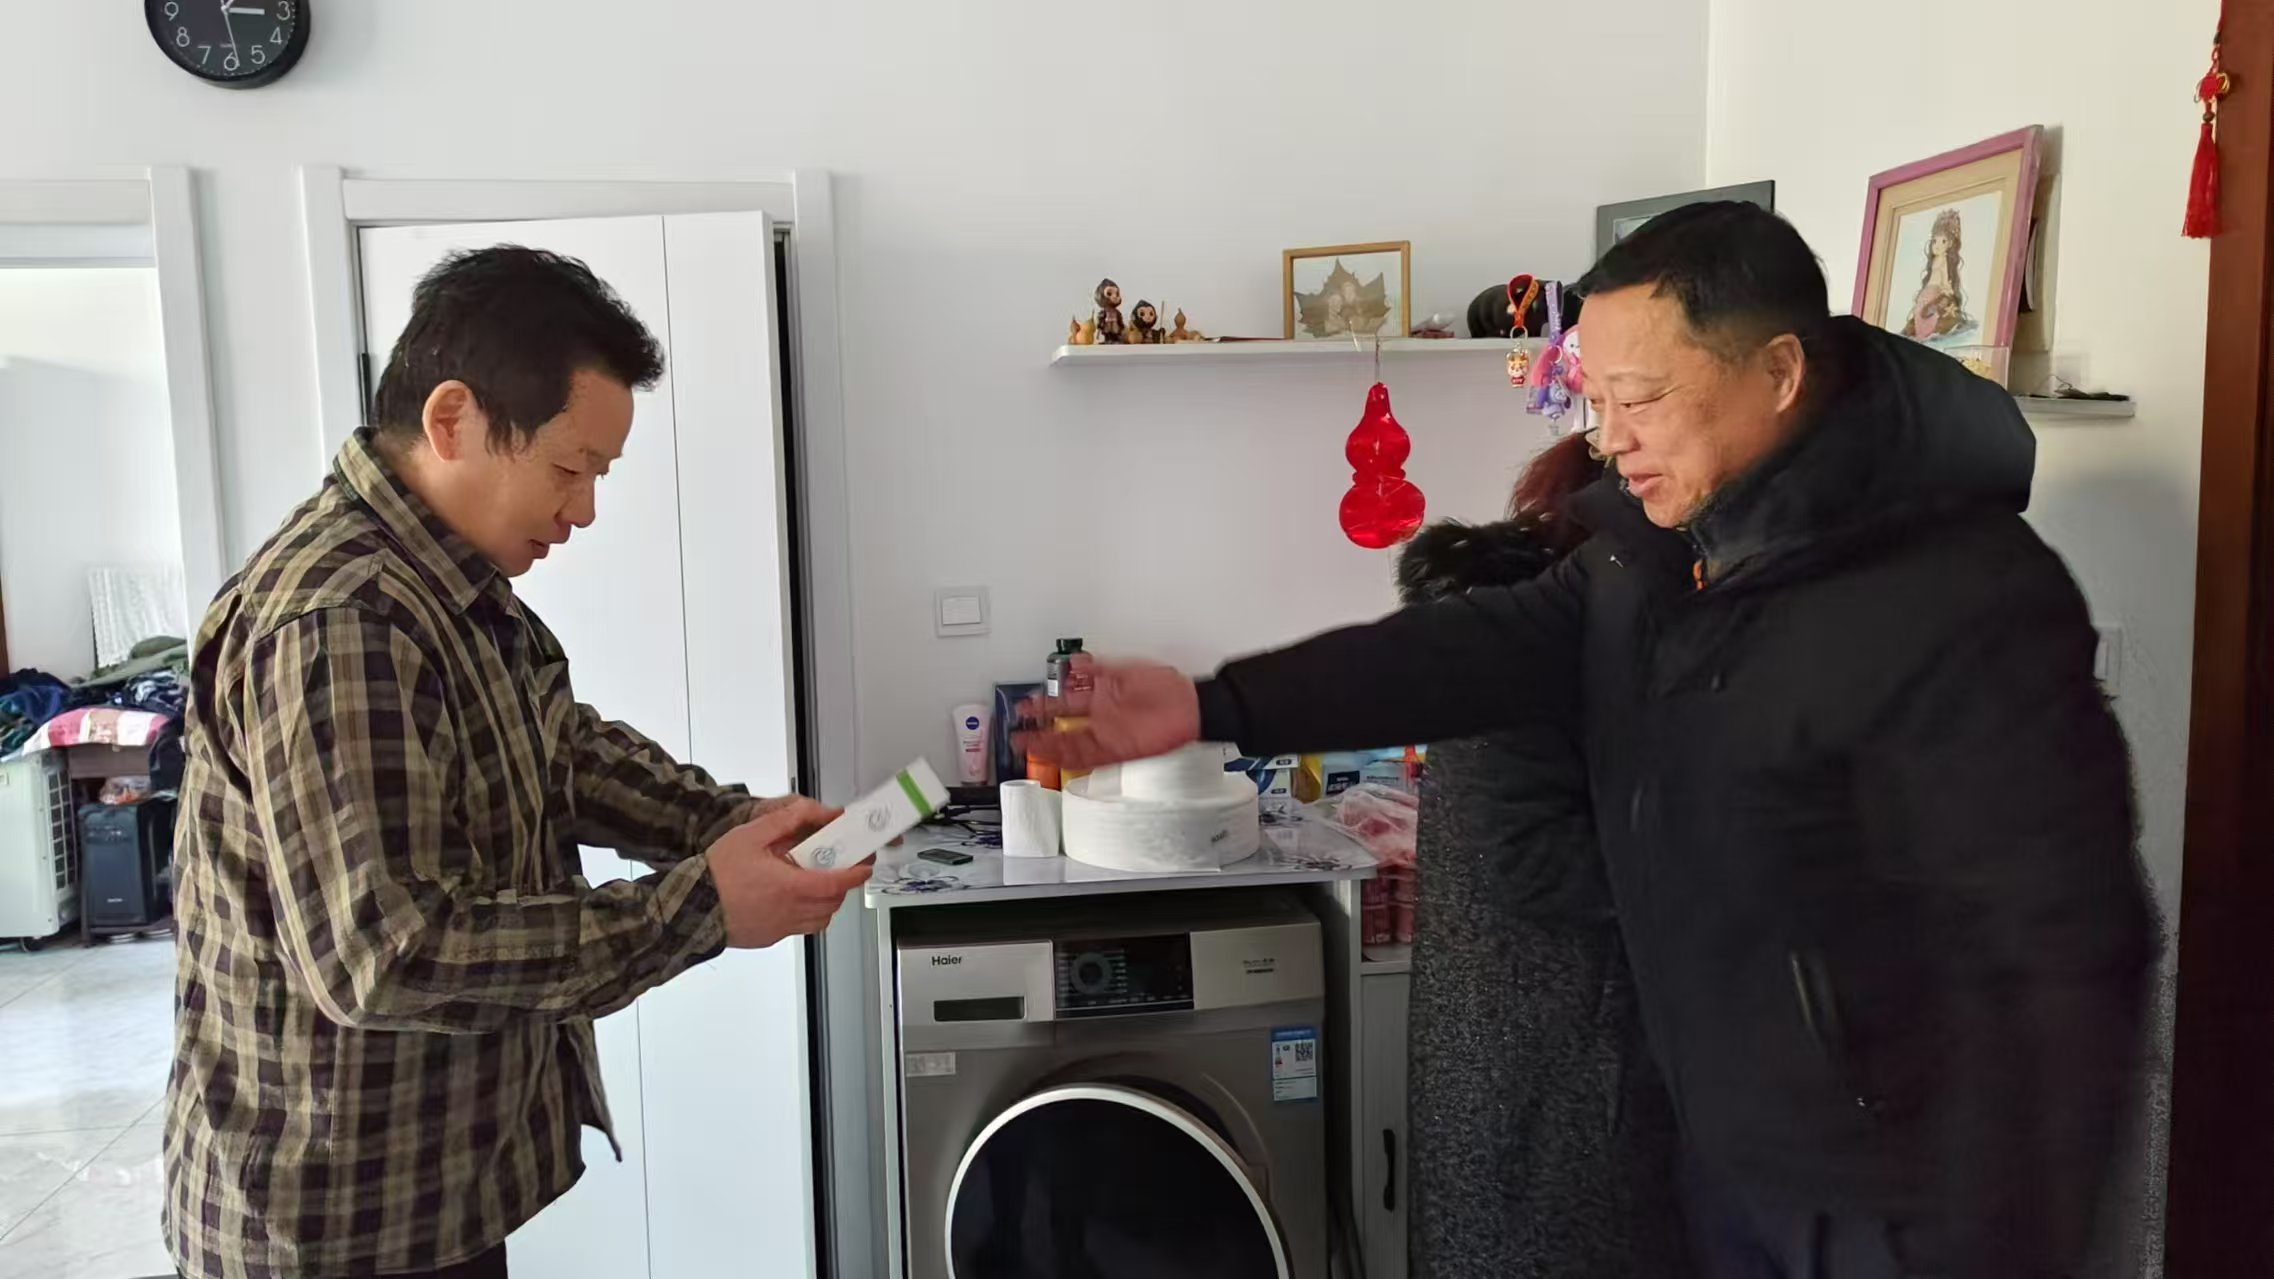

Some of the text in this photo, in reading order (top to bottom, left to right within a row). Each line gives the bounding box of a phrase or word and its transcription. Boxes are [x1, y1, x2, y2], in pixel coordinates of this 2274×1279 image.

[164, 1, 179, 21] 9
[276, 0, 291, 21] 3
[176, 26, 190, 48] 8
[269, 27, 283, 44] 4
[197, 45, 211, 65] 7
[223, 51, 239, 71] 6
[251, 45, 265, 65] 5
[931, 954, 962, 966] Haier
